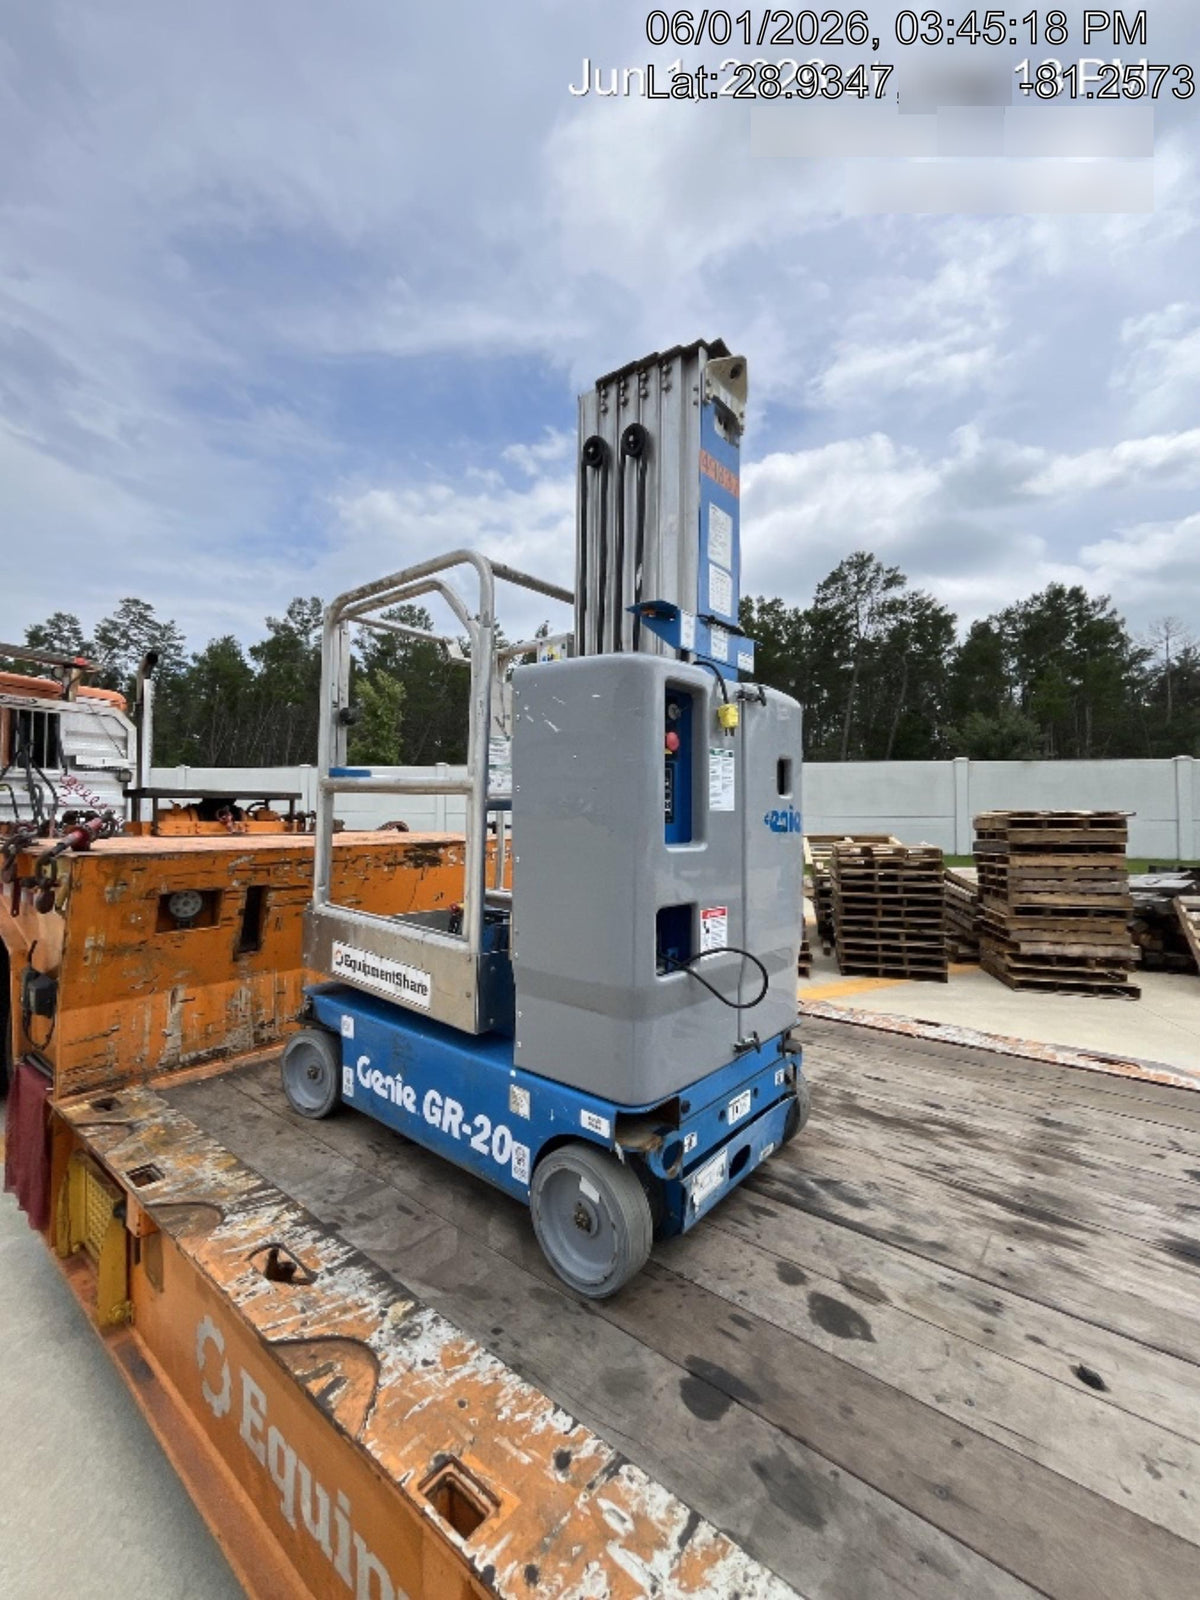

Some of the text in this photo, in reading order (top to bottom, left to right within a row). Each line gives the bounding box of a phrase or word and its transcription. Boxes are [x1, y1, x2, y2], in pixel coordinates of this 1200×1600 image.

[344, 953, 428, 997] EquipmentShare
[357, 1055, 416, 1114] Genie
[423, 1089, 513, 1165] GR-20
[239, 1366, 410, 1600] Equip
